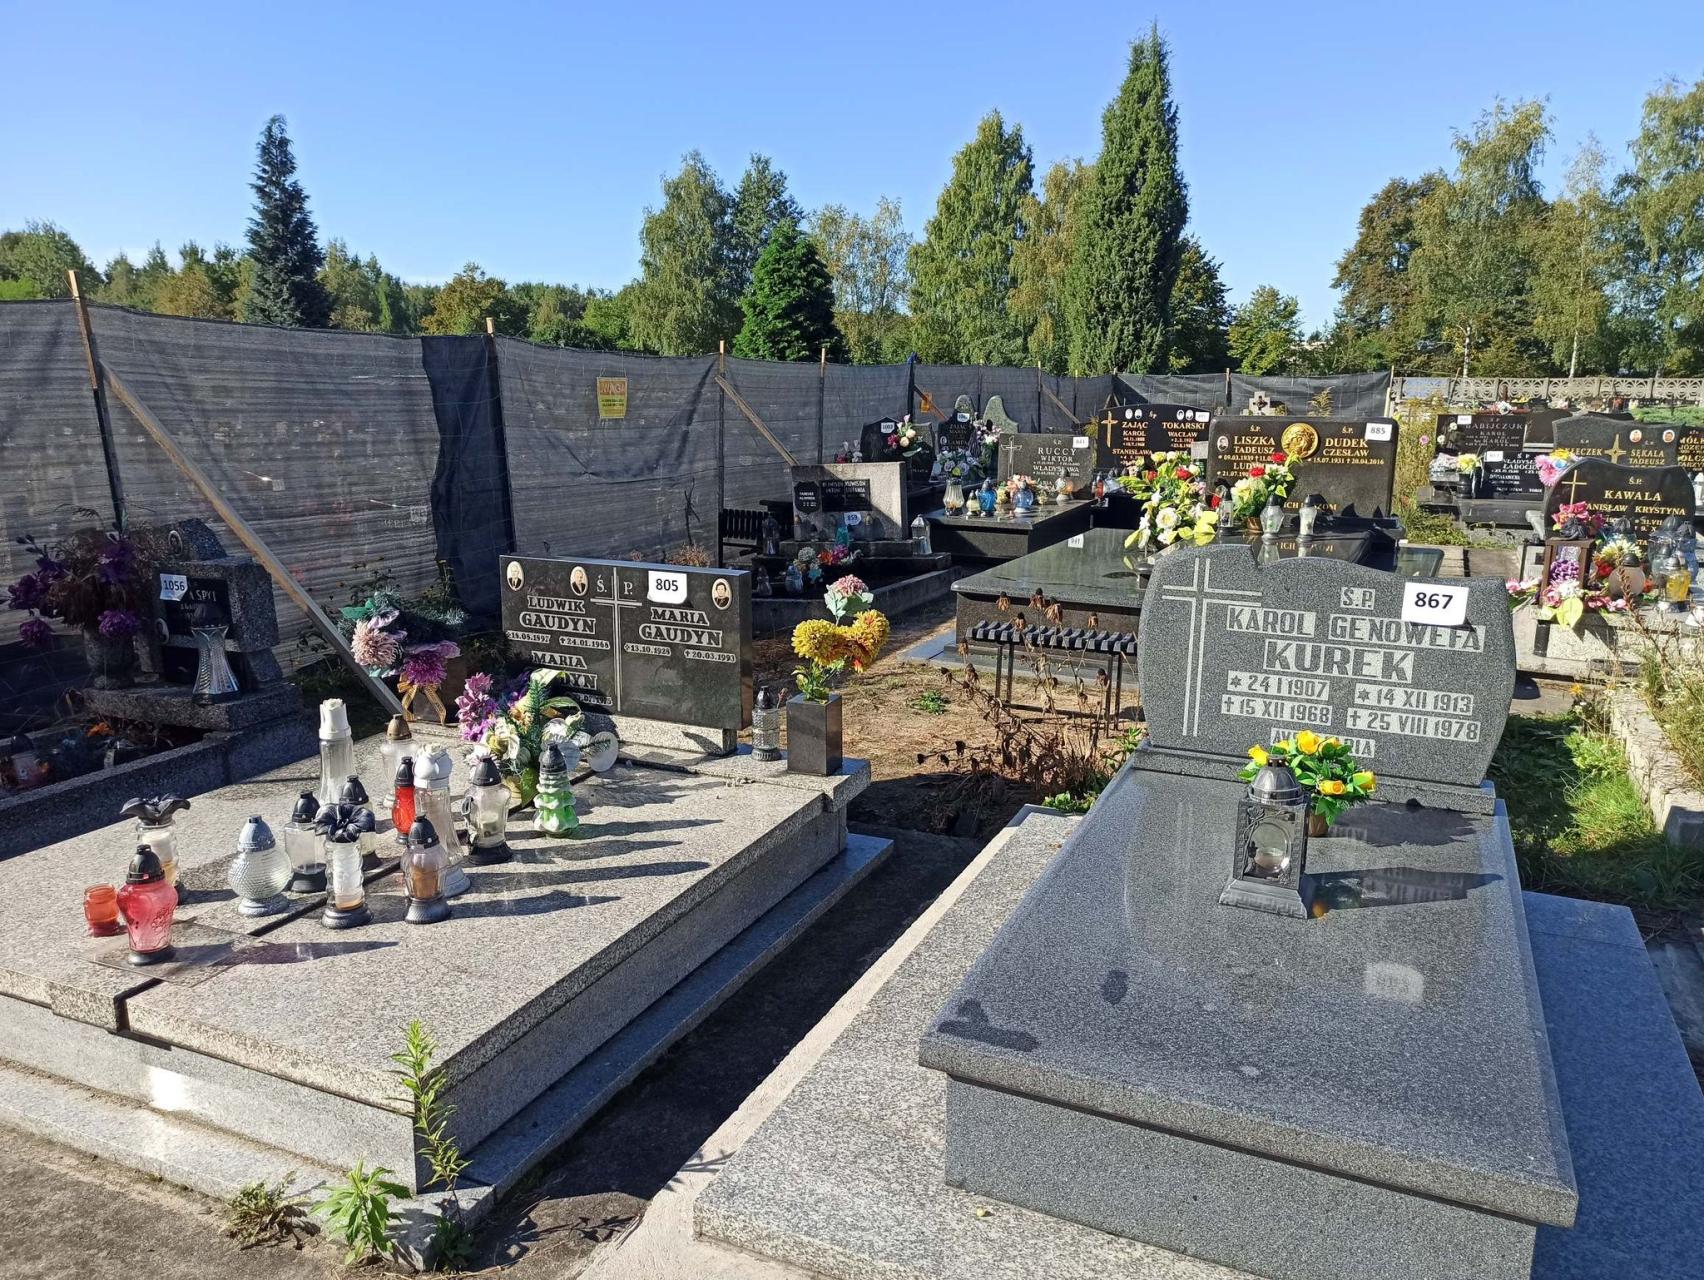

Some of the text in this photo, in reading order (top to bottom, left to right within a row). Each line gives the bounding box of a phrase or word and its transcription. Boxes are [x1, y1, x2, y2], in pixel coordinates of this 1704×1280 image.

[1162, 422, 1205, 430] TOKARSKI
[1370, 426, 1386, 435] 885
[1233, 436, 1276, 446] LISZKA
[1325, 437, 1369, 448] DUDEK
[1038, 447, 1077, 456] RUCCY
[1233, 446, 1276, 454] TADEUSZ
[1629, 457, 1666, 465] TADEUSZ
[1604, 490, 1661, 501] KAWALA
[1635, 505, 1686, 516] KRYSTYNA
[164, 580, 185, 591] 1056
[655, 578, 679, 592] 805
[528, 597, 585, 613] LUDWIK
[1414, 591, 1454, 609] 867
[521, 613, 596, 633] GAUDYN
[651, 608, 709, 625] MARIA
[640, 625, 722, 647] GAUDYN
[1228, 606, 1481, 651] KAROL GENOWEFA
[532, 652, 587, 668] MARIA
[1265, 640, 1411, 682] KUREK
[1247, 674, 1270, 693] 24
[1286, 678, 1328, 698] 1907
[1376, 687, 1472, 713] 14 XII 1913
[1239, 697, 1330, 724] 15 XII 1968
[1367, 711, 1479, 740] 25 VIII 1978
